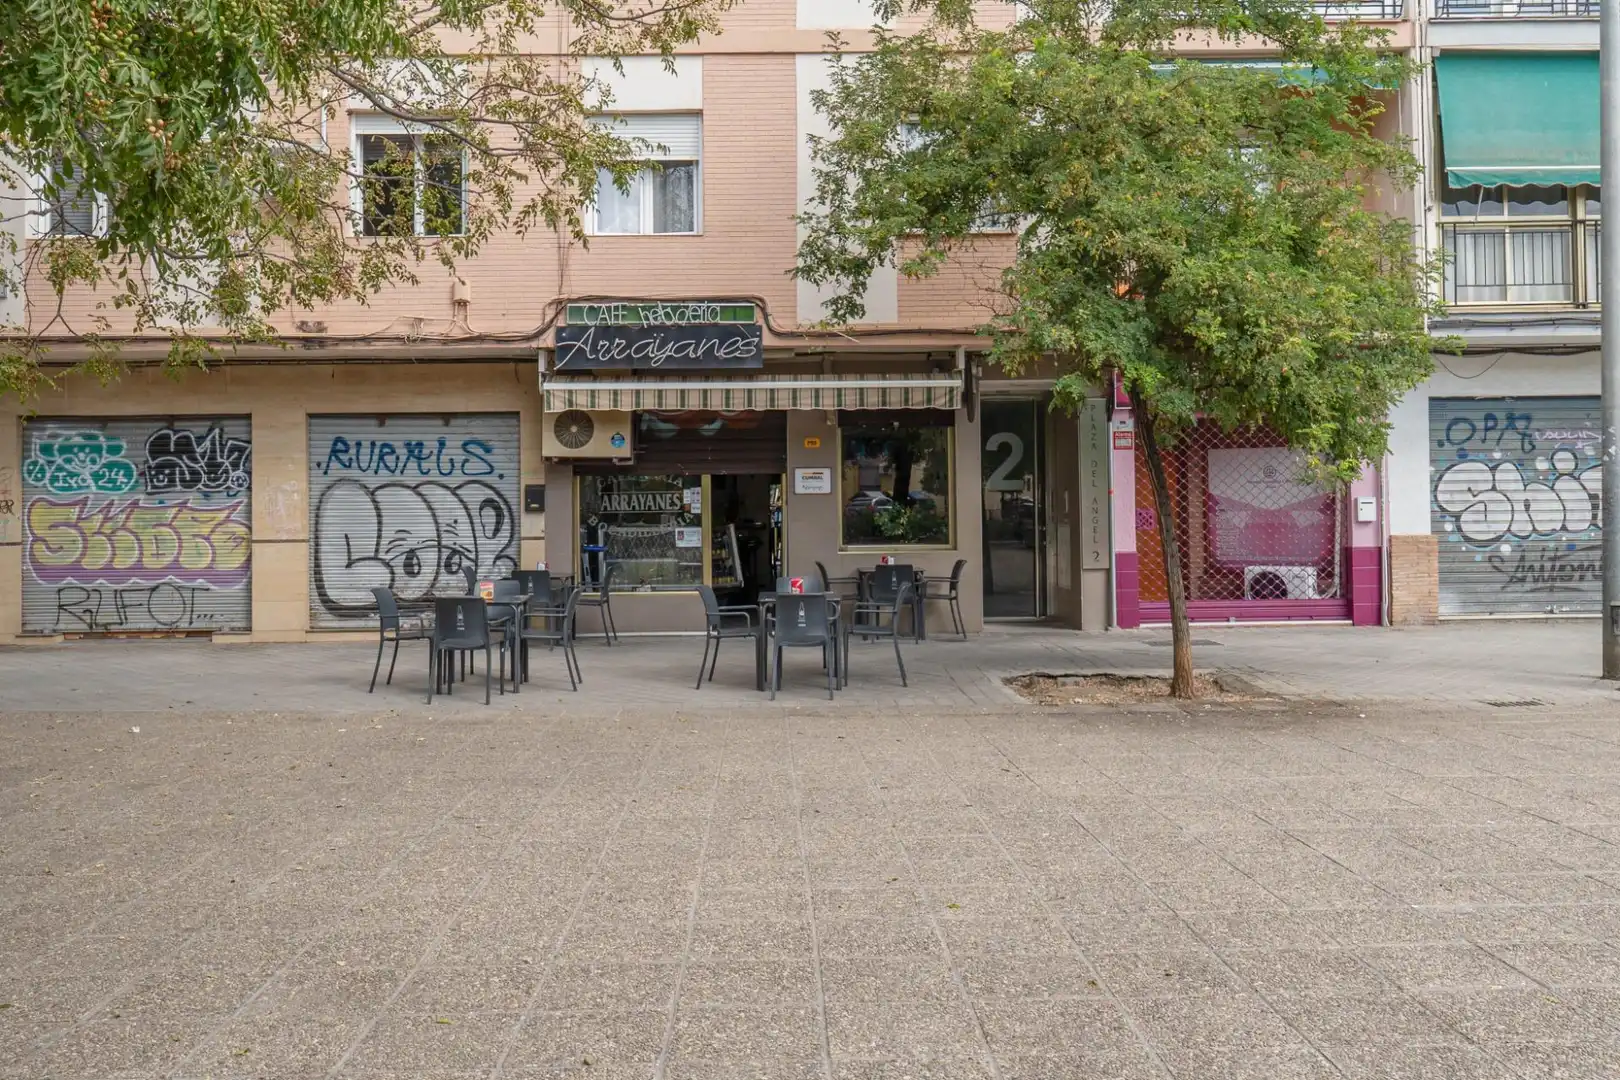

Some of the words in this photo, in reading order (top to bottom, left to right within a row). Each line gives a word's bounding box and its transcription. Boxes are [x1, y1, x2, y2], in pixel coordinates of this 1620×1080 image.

[583, 303, 629, 325] CAFE
[985, 432, 1024, 491] 2
[601, 492, 681, 511] ARRAYANES
